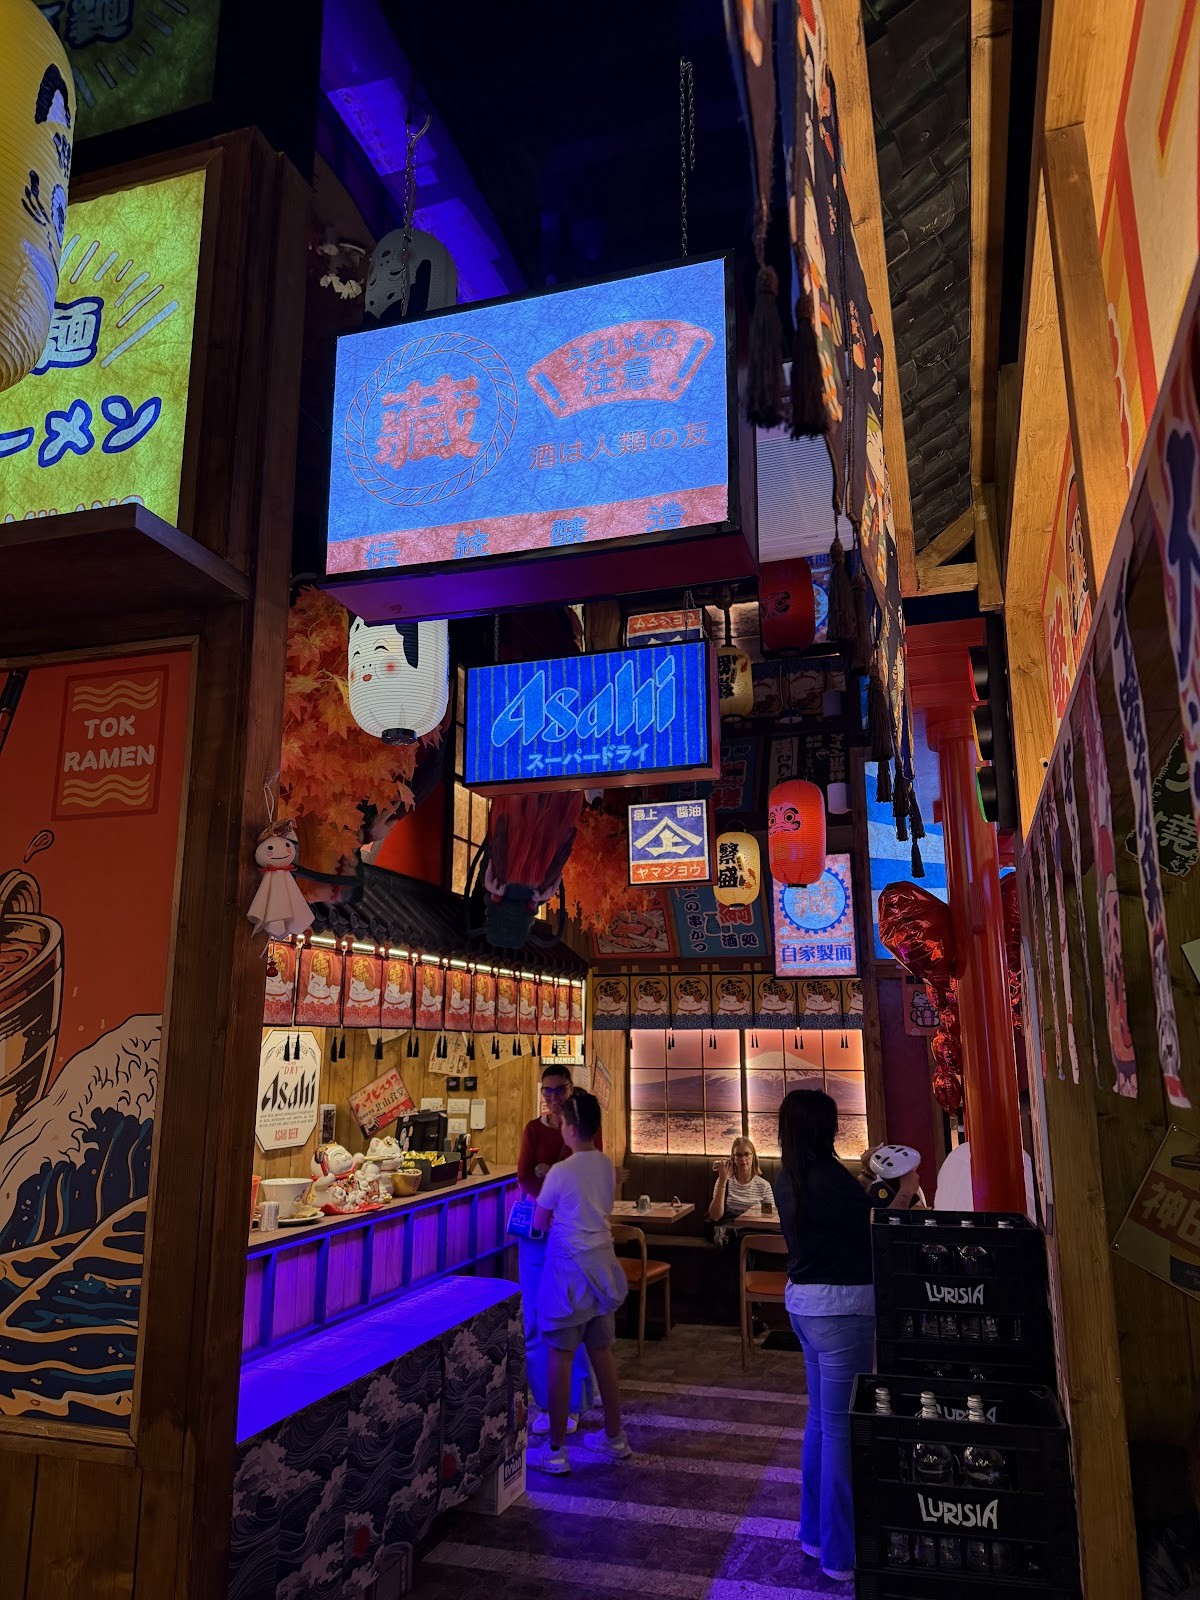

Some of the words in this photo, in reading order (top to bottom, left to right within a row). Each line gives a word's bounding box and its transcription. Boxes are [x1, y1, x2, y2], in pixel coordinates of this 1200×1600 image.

[566, 328, 678, 372] うまいもの
[583, 356, 655, 397] 注意
[528, 420, 711, 471] 酒は人類の友
[491, 654, 676, 748] Asahi
[83, 714, 136, 740] TOK
[63, 744, 155, 773] RAMEN
[526, 742, 649, 772] スーパードライ
[782, 943, 852, 963] 自家製面
[261, 1069, 317, 1112] Asahi
[924, 1281, 985, 1306] LURISIA
[916, 1493, 999, 1530] LURISIA
